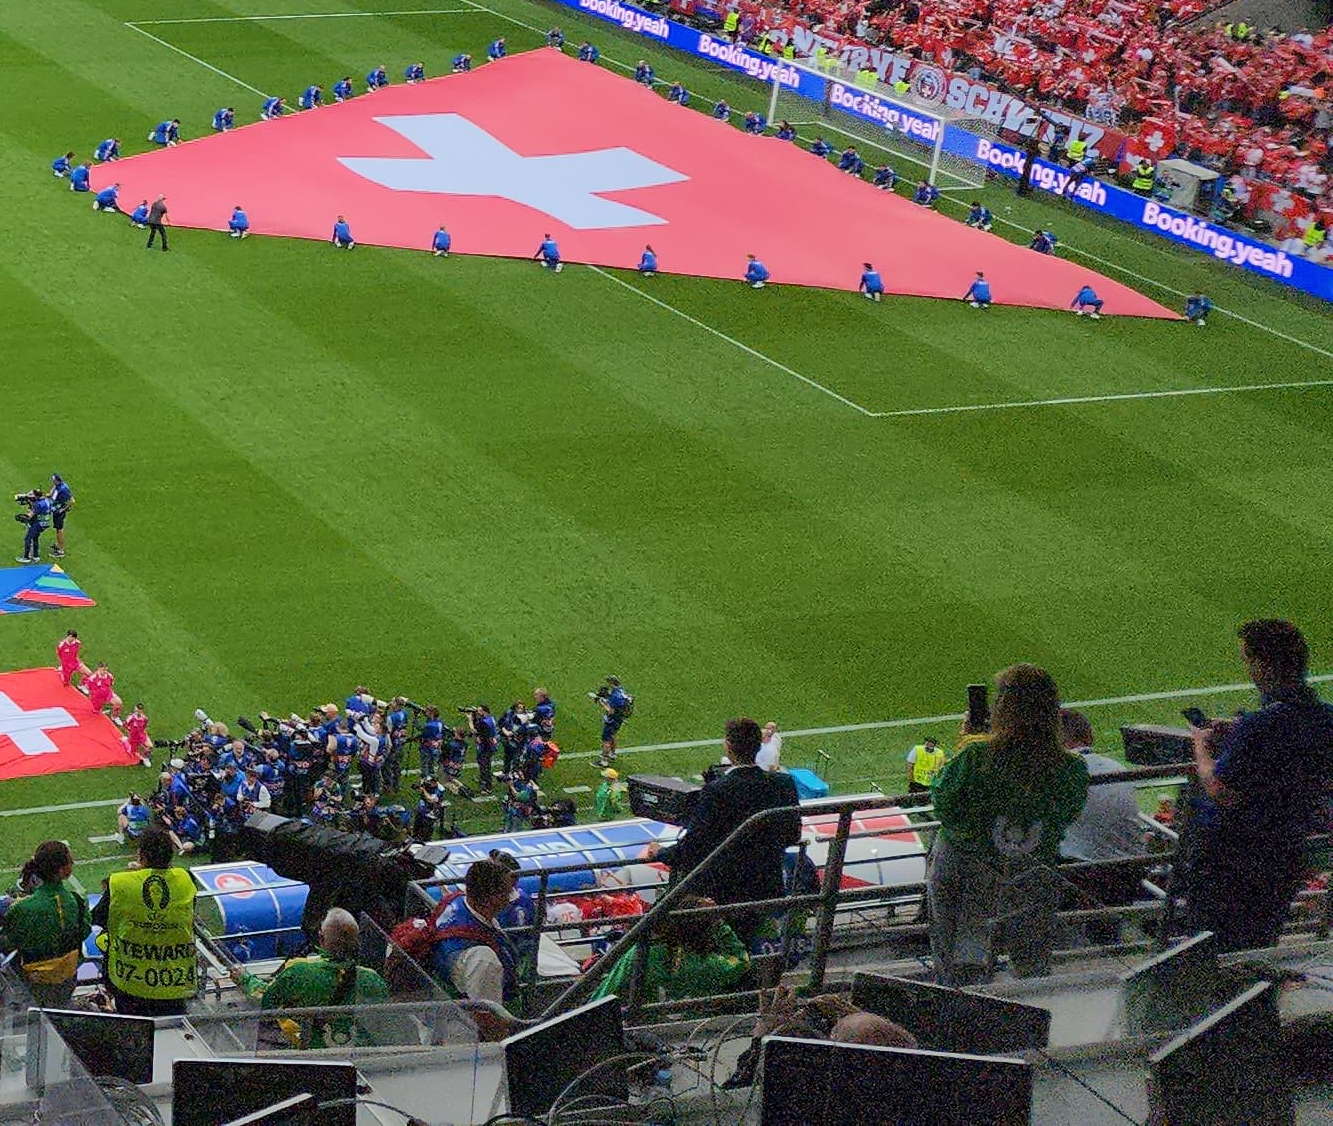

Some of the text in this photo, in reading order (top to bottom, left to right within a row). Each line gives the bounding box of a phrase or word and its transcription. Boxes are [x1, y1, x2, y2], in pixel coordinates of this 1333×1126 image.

[698, 35, 799, 88] Booking.yeah
[977, 139, 1106, 206] Bookng.yah
[1142, 201, 1293, 277] Booking.yeah
